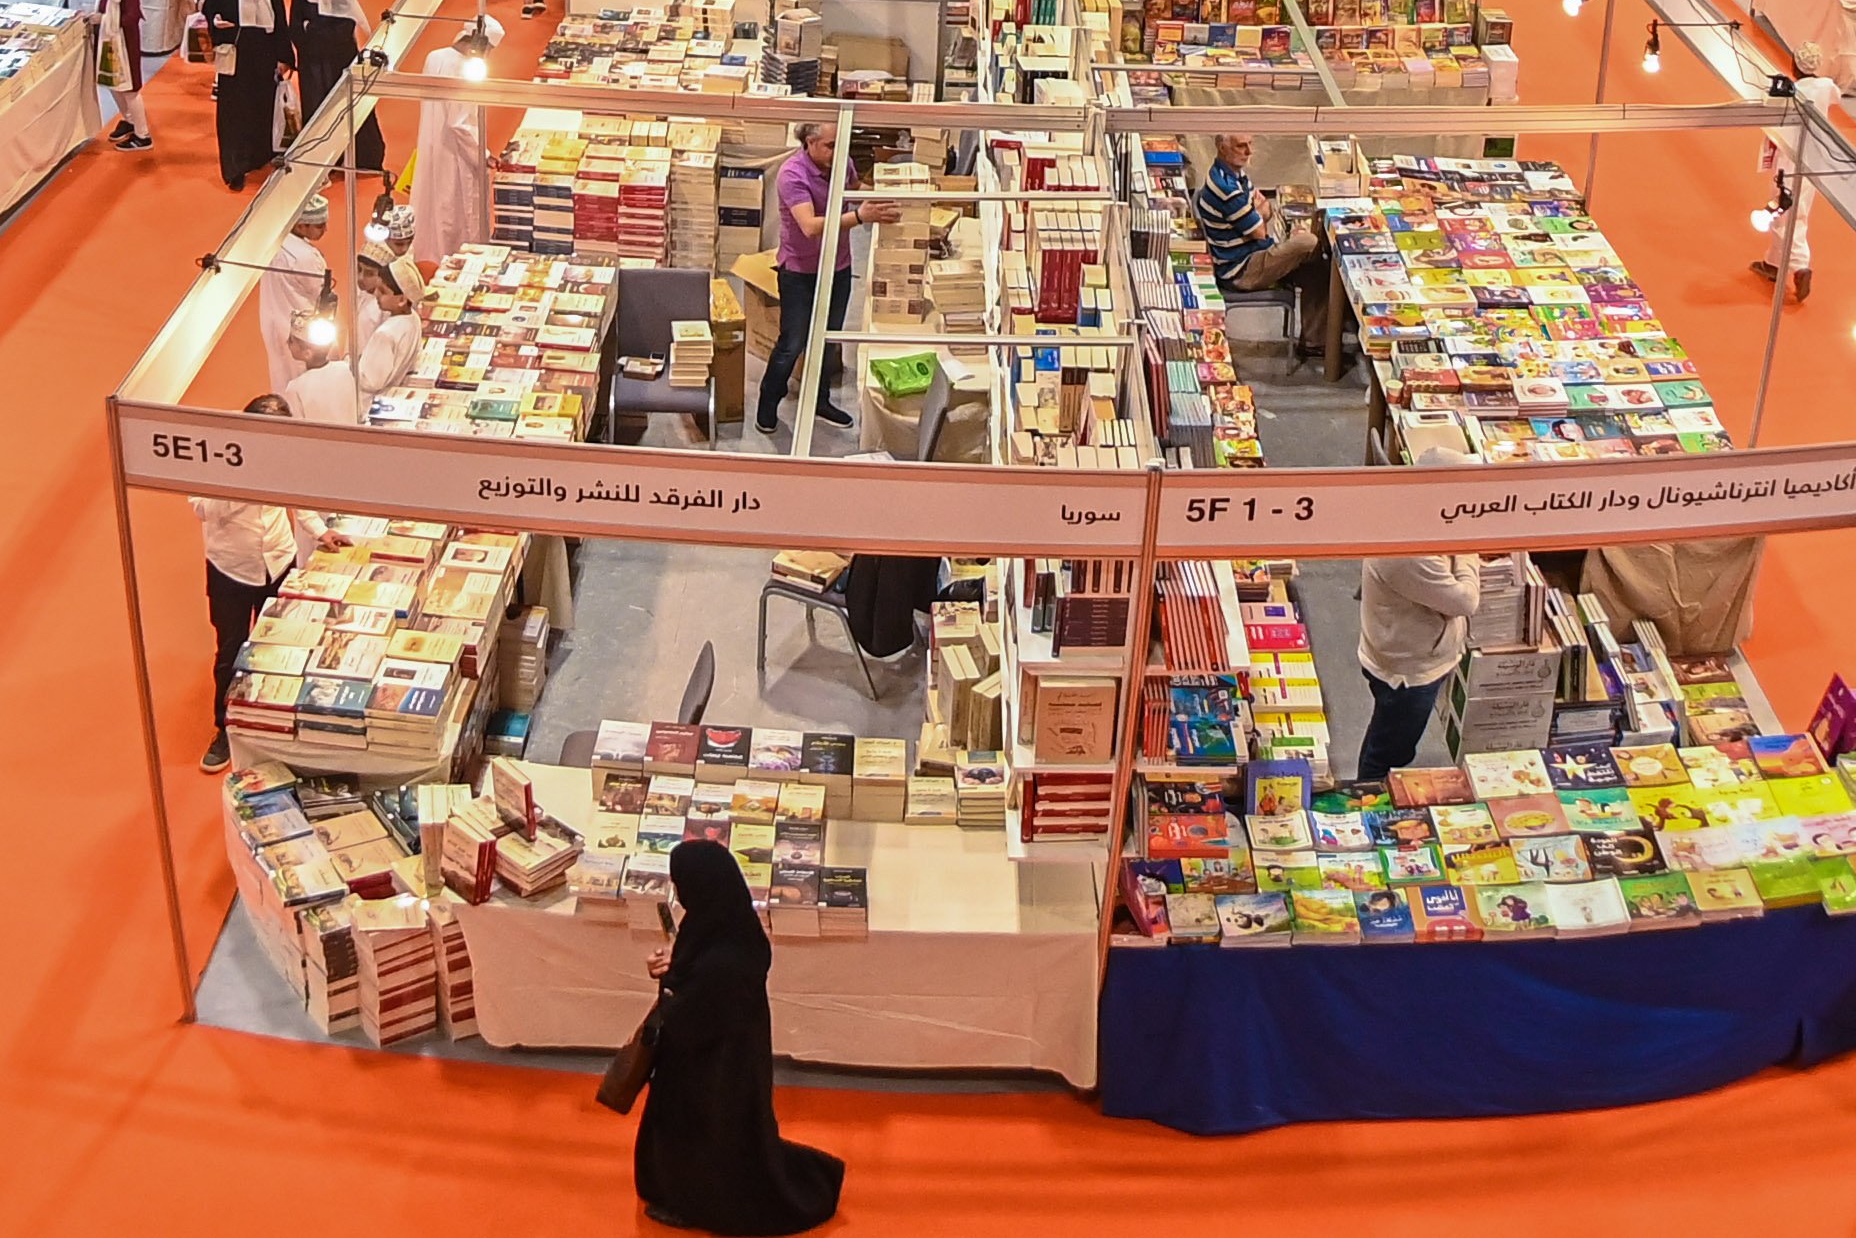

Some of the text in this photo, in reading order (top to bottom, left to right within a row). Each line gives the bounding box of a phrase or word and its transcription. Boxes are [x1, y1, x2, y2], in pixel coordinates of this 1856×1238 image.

[152, 433, 244, 468] 5E1-3
[477, 475, 761, 514] دار الفرقد للنشر والتوزيع
[1186, 497, 1232, 523] 5F
[1242, 496, 1256, 521] 1
[1293, 495, 1315, 522] 3
[1439, 493, 1519, 525] العربي
[1523, 490, 1593, 517] الكتاب
[1597, 488, 1641, 513] ودار
[1646, 478, 1778, 511] انترناشيونال
[1060, 504, 1121, 525] سوريا
